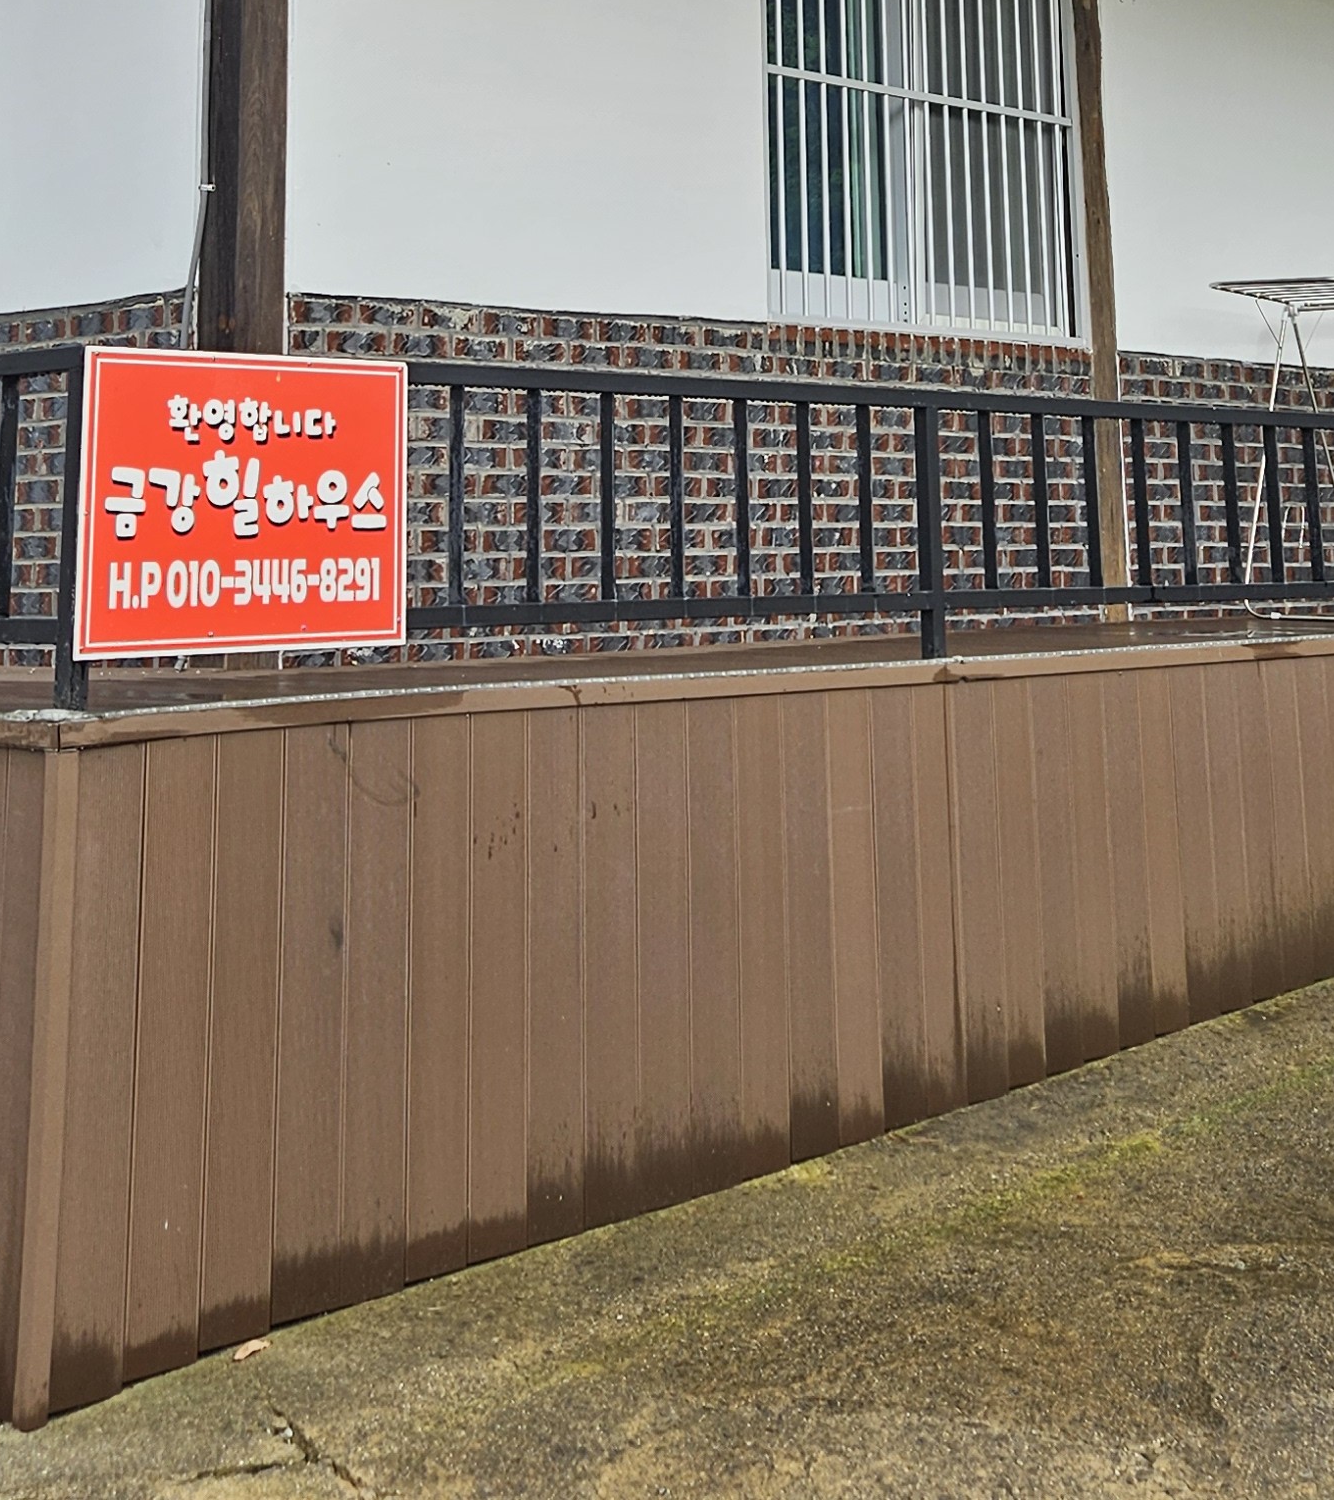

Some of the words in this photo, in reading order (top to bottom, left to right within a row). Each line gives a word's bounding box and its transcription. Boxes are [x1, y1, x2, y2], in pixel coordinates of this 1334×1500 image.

[167, 394, 337, 443] 환영합니다
[104, 450, 387, 538] 금강힐하우스
[108, 561, 162, 609] H.P
[167, 557, 381, 608] 010-3446-8291
